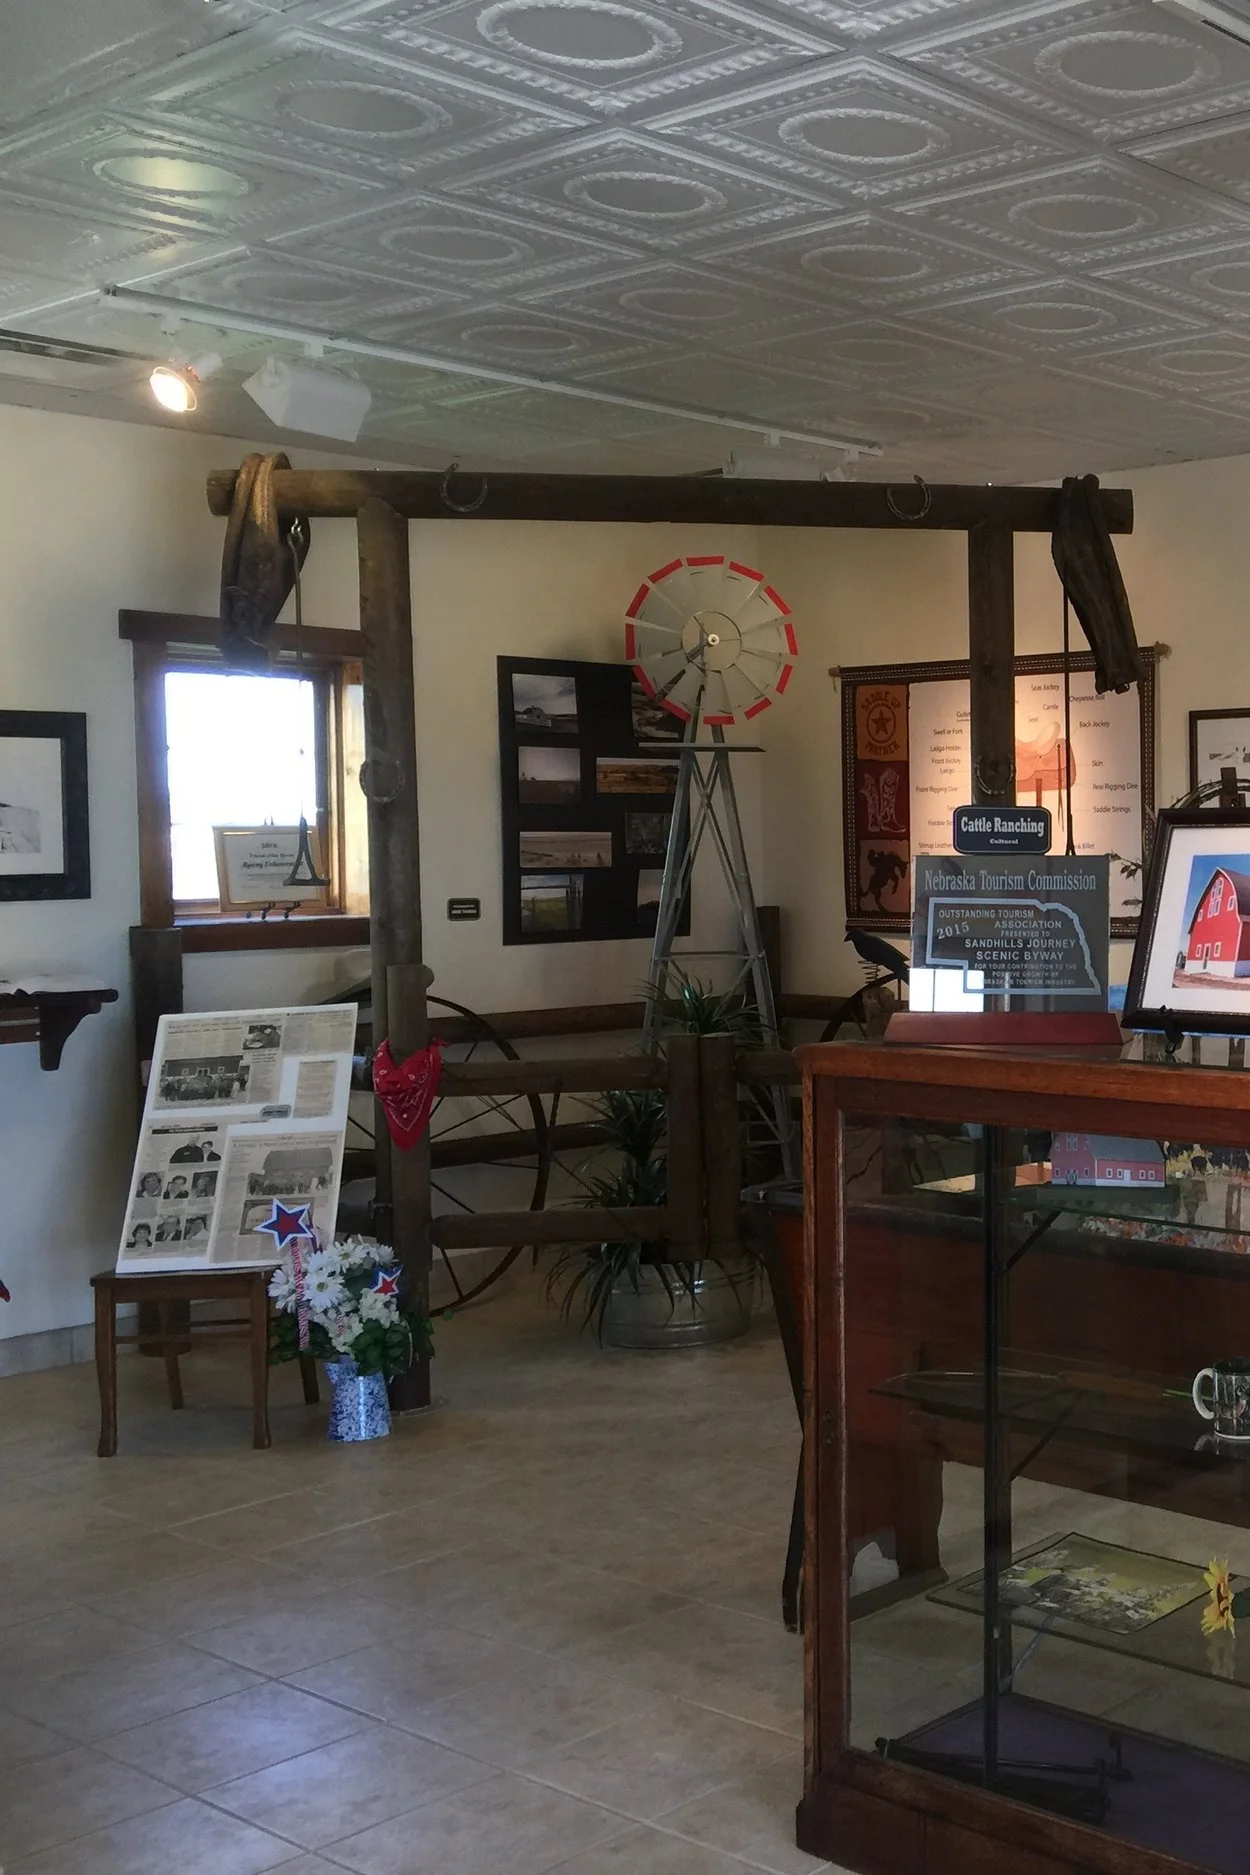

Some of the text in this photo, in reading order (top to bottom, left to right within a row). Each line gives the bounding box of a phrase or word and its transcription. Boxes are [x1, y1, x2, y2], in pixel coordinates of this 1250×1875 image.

[1105, 782, 1126, 792] Rigging
[1127, 782, 1138, 790] Dee
[1112, 806, 1132, 814] Strings
[961, 816, 1045, 837] Cattle Ranching
[925, 870, 1097, 890] Nebraska Tourism Commission
[938, 909, 1035, 919] OUTSTANDING TOURISM
[994, 920, 1062, 929] ASSOCIATION
[936, 921, 970, 940] 2015
[965, 938, 1076, 949] SANDHILLS JOURNEY
[976, 951, 1064, 960] SCENIC BYWAY
